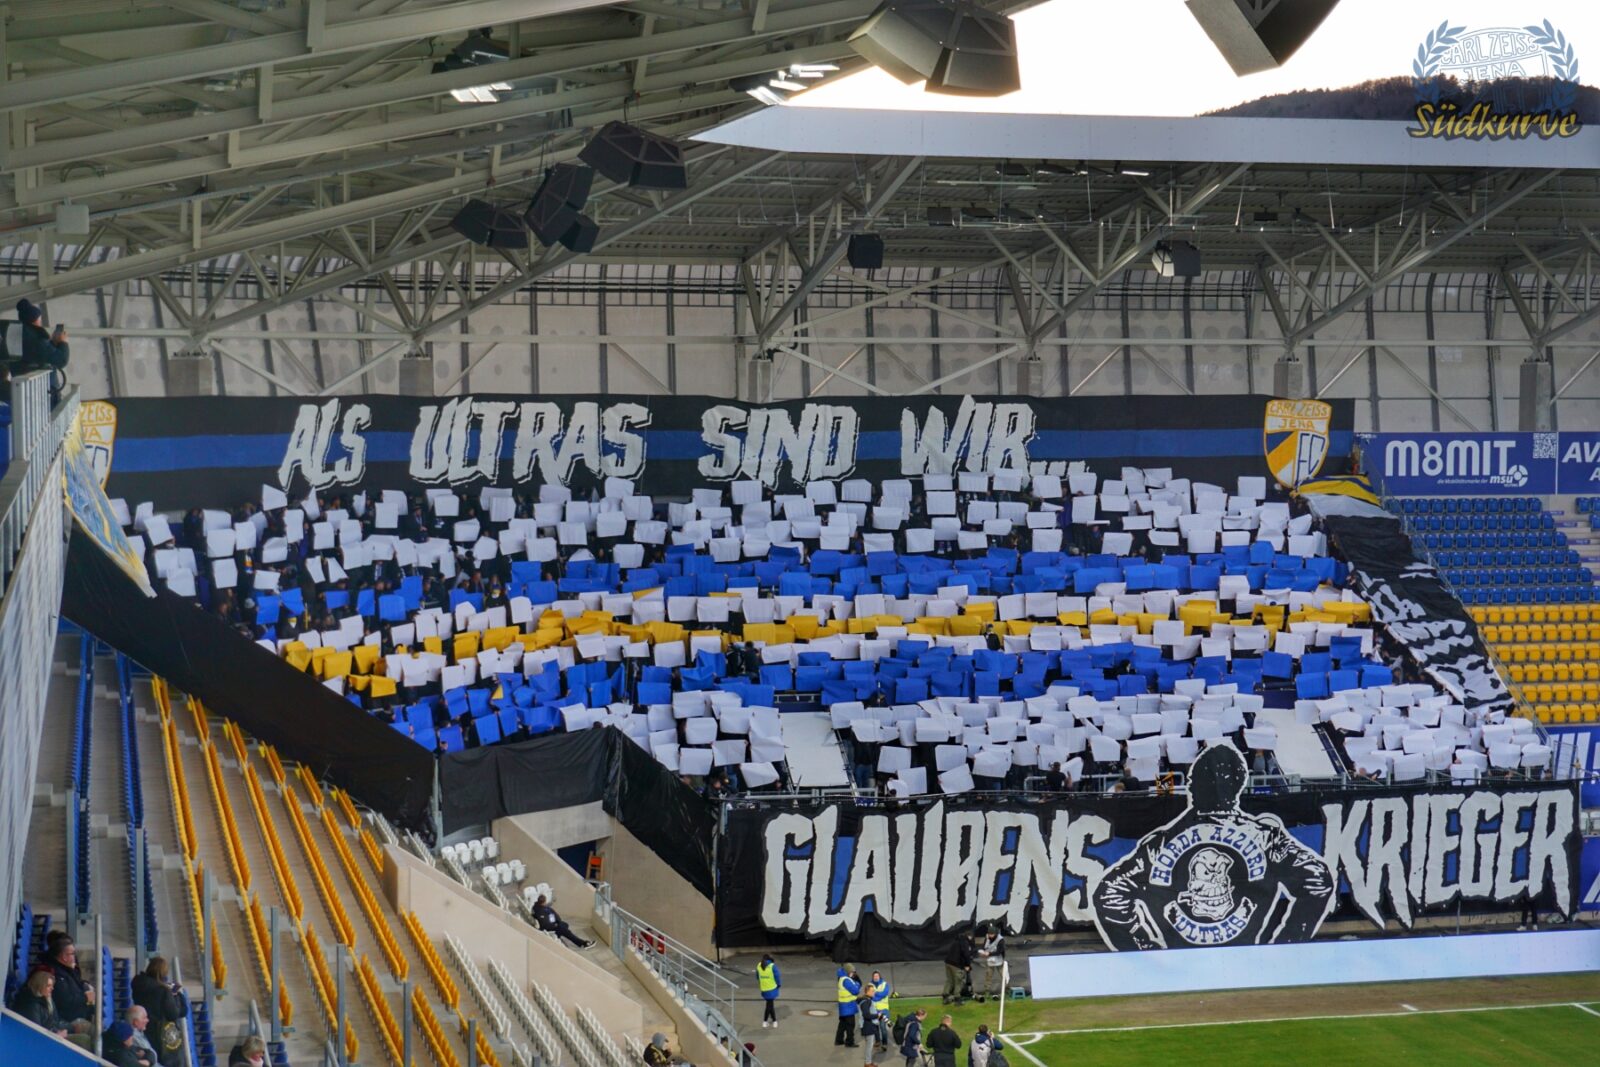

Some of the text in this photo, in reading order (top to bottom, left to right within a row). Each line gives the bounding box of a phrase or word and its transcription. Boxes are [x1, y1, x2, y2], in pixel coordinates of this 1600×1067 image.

[1279, 419, 1315, 429] JENA
[1296, 401, 1328, 417] ZEISS
[278, 398, 371, 489] ALS
[409, 397, 652, 488] ULTRAS
[698, 403, 860, 488] SIND
[1296, 433, 1326, 487] FC
[1385, 440, 1516, 477] M8MIT
[1561, 441, 1600, 463] AV
[1489, 475, 1513, 484] msu
[760, 800, 1112, 937] GLAUBENS
[1151, 826, 1265, 884] HORDA AZZURO
[1321, 789, 1575, 930] KRIEGER
[1176, 914, 1248, 943] ULTRAS
